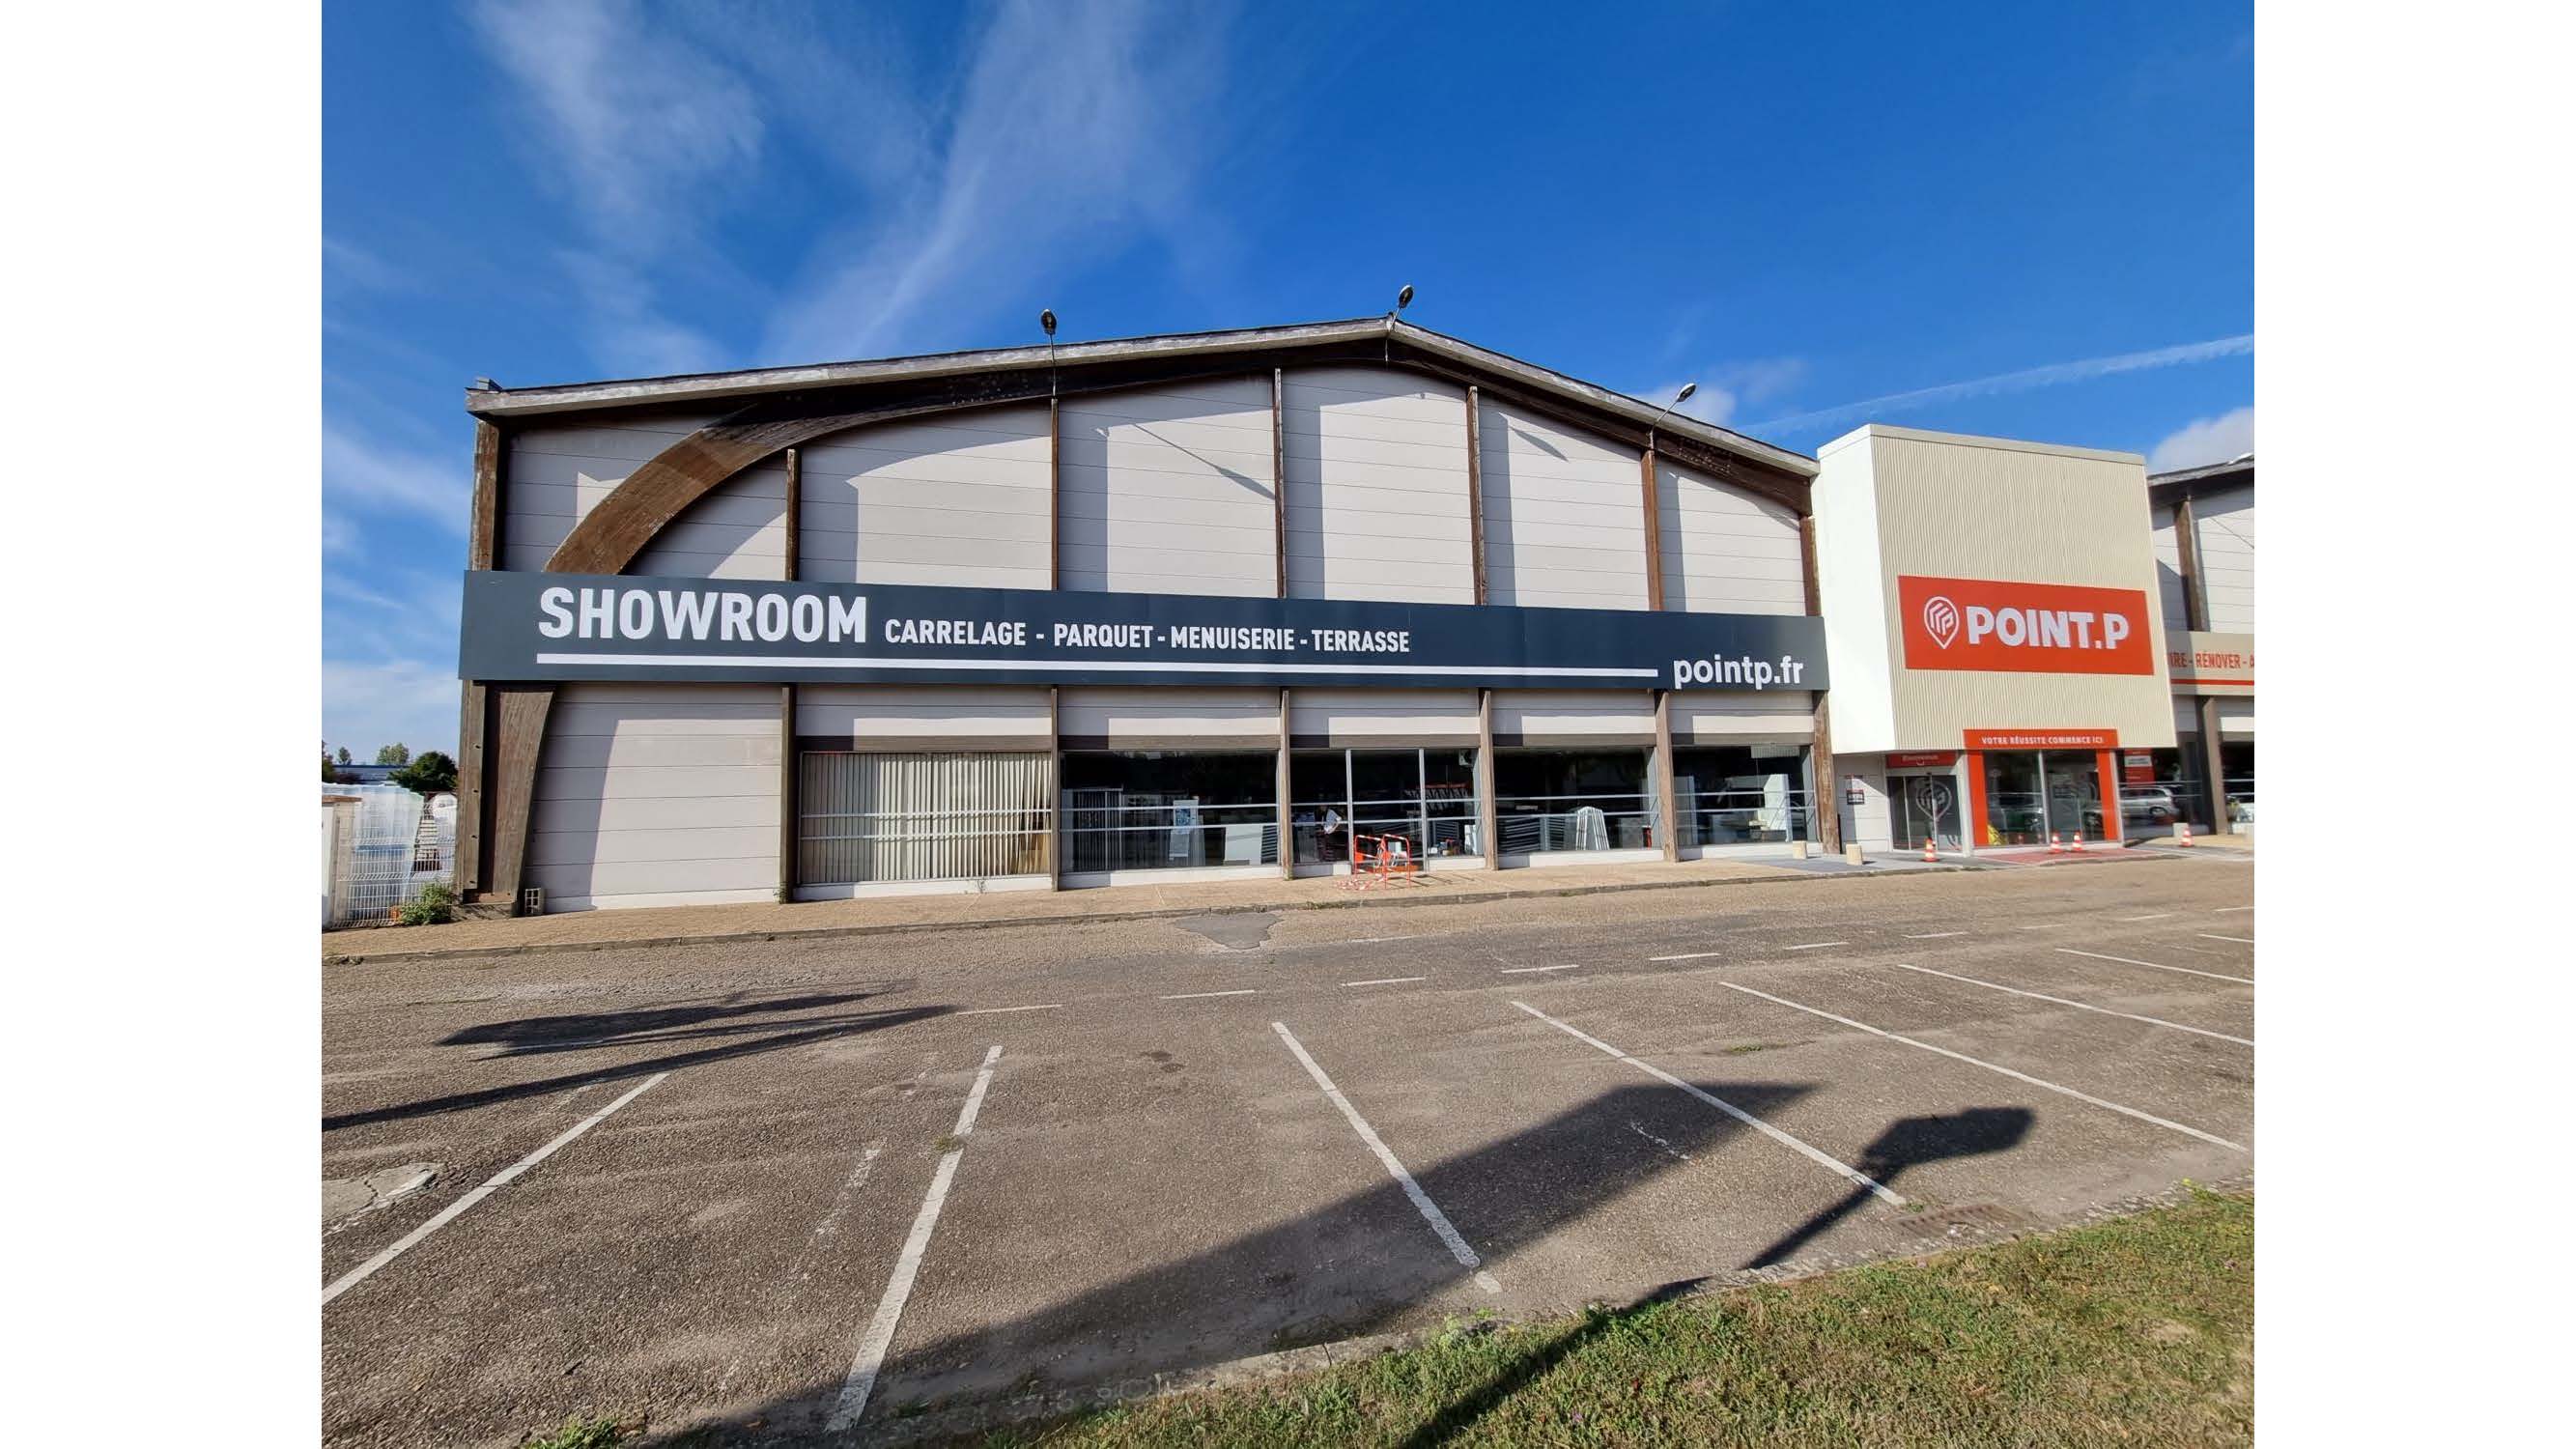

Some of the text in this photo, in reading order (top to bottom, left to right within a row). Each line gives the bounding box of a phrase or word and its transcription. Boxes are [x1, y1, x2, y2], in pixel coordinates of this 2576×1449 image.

[538, 586, 866, 643] SHOWROOM
[1966, 606, 2130, 650] POINT.P
[885, 618, 1027, 646] CARRELAGE
[1054, 623, 1154, 648] PARQUET
[1171, 625, 1295, 650] MENUISERIE
[1311, 629, 1410, 653] TERRASSE
[1673, 653, 1804, 691] pointp.fr
[1981, 736, 2009, 745] VOTRE
